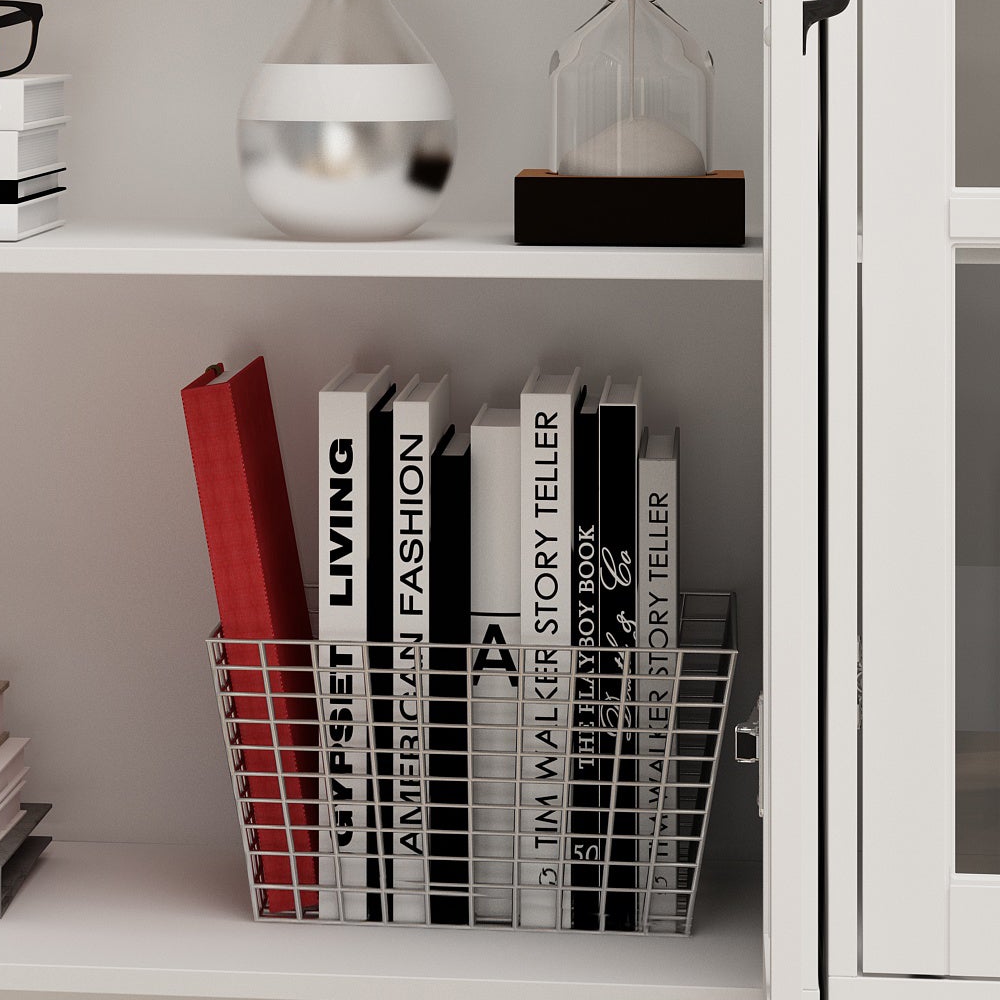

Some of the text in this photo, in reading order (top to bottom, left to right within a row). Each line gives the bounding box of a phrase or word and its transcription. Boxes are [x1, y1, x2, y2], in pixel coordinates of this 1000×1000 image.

[329, 438, 354, 606] LIVING
[399, 434, 424, 615] FASHION
[578, 524, 596, 594] BOOK
[648, 492, 670, 582] TELLER
[600, 546, 633, 591] Co
[473, 623, 519, 687] A
[534, 411, 559, 849] TIM WALKER STORY TELLER
[648, 591, 670, 676] STORY
